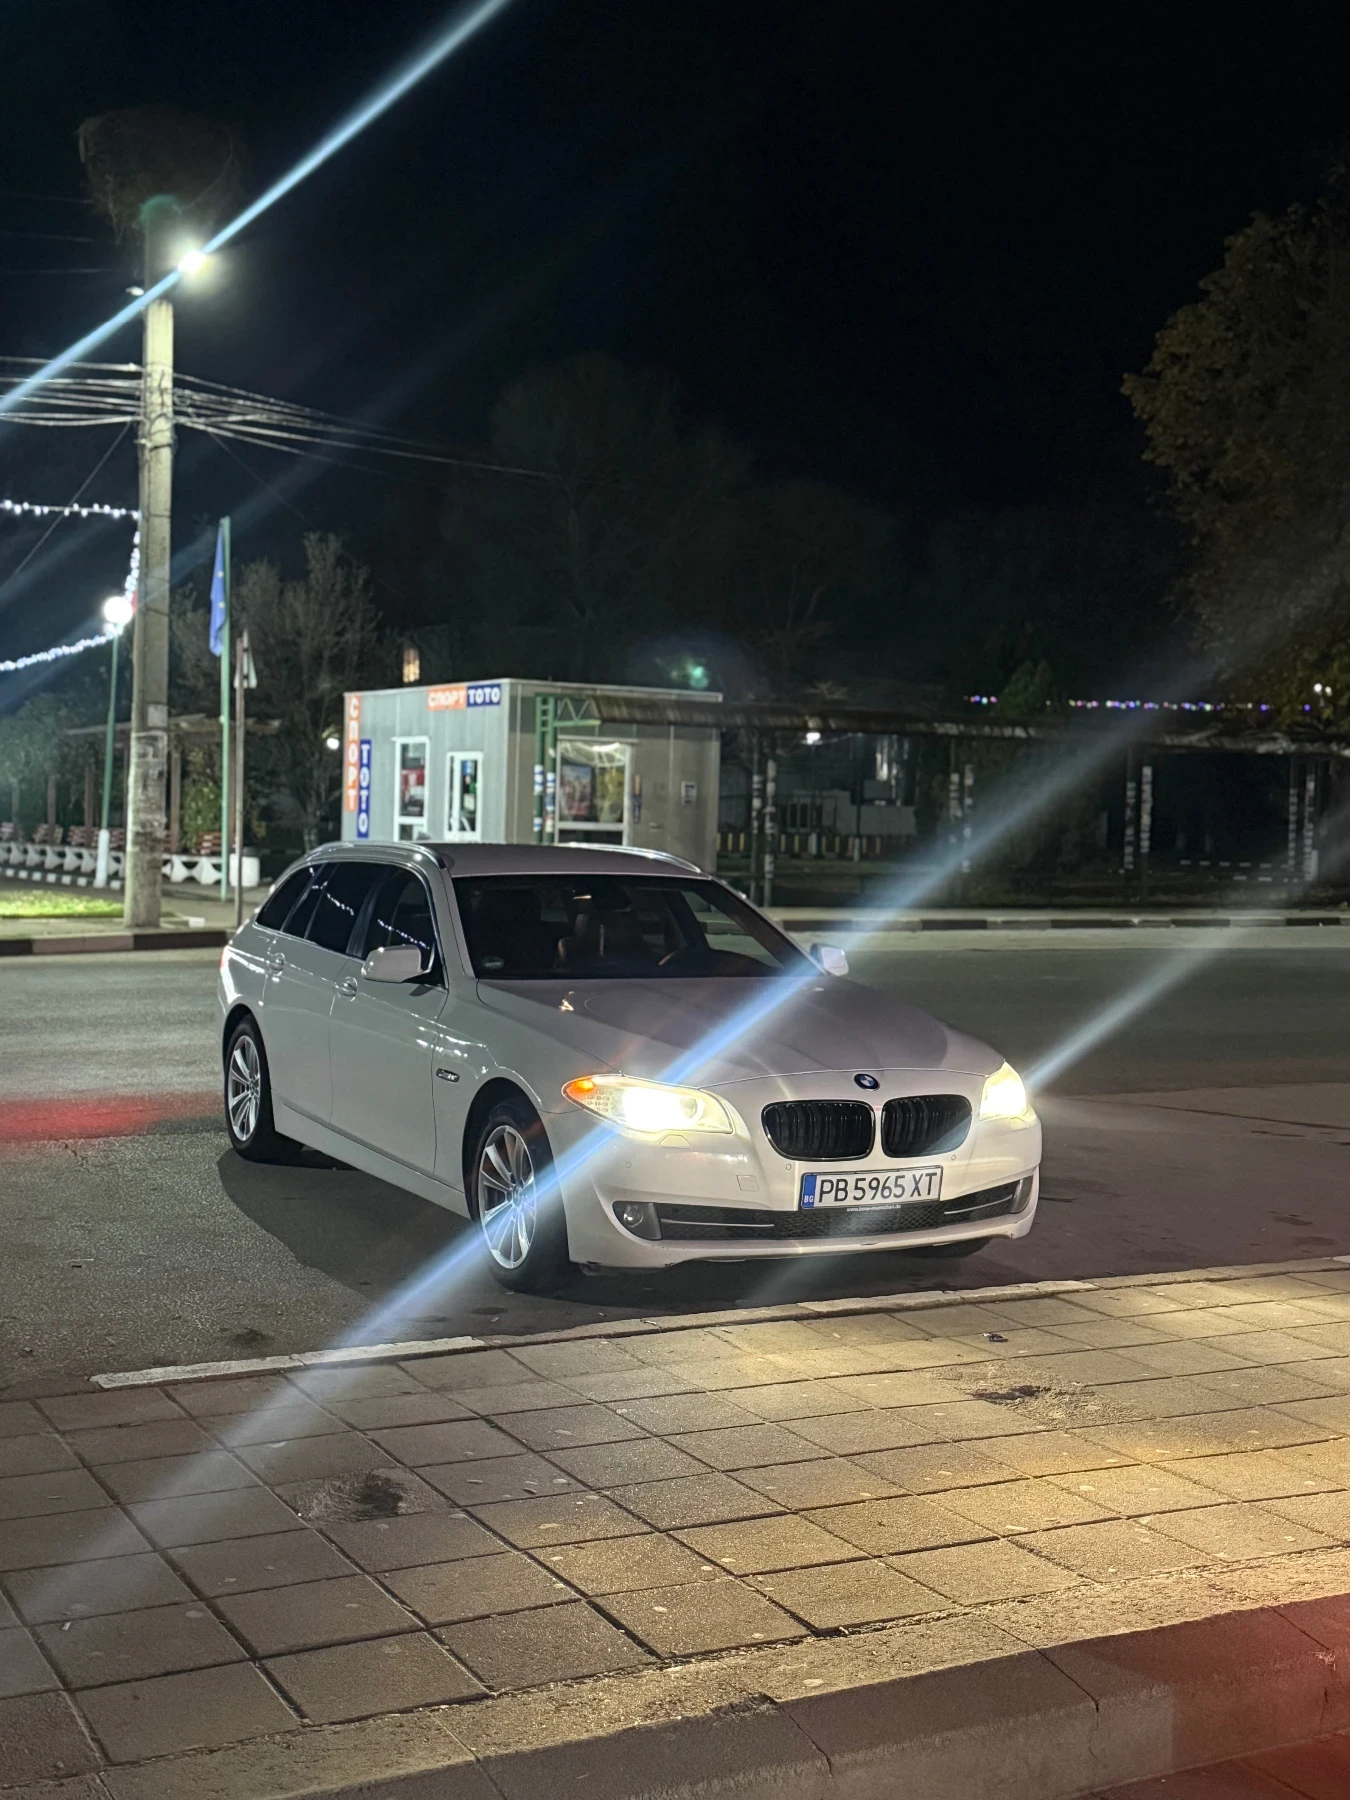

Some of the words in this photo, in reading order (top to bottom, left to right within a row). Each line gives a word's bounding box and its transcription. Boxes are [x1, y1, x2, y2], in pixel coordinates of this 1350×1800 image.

[428, 689, 466, 707] СПОРТ
[468, 687, 501, 704] ТОТО
[348, 696, 359, 810] СПОРТ
[358, 744, 370, 834] ТОТО
[803, 1195, 814, 1203] BG
[818, 1178, 849, 1203] PB
[852, 1175, 906, 1201] 5965
[910, 1173, 938, 1198] XT
